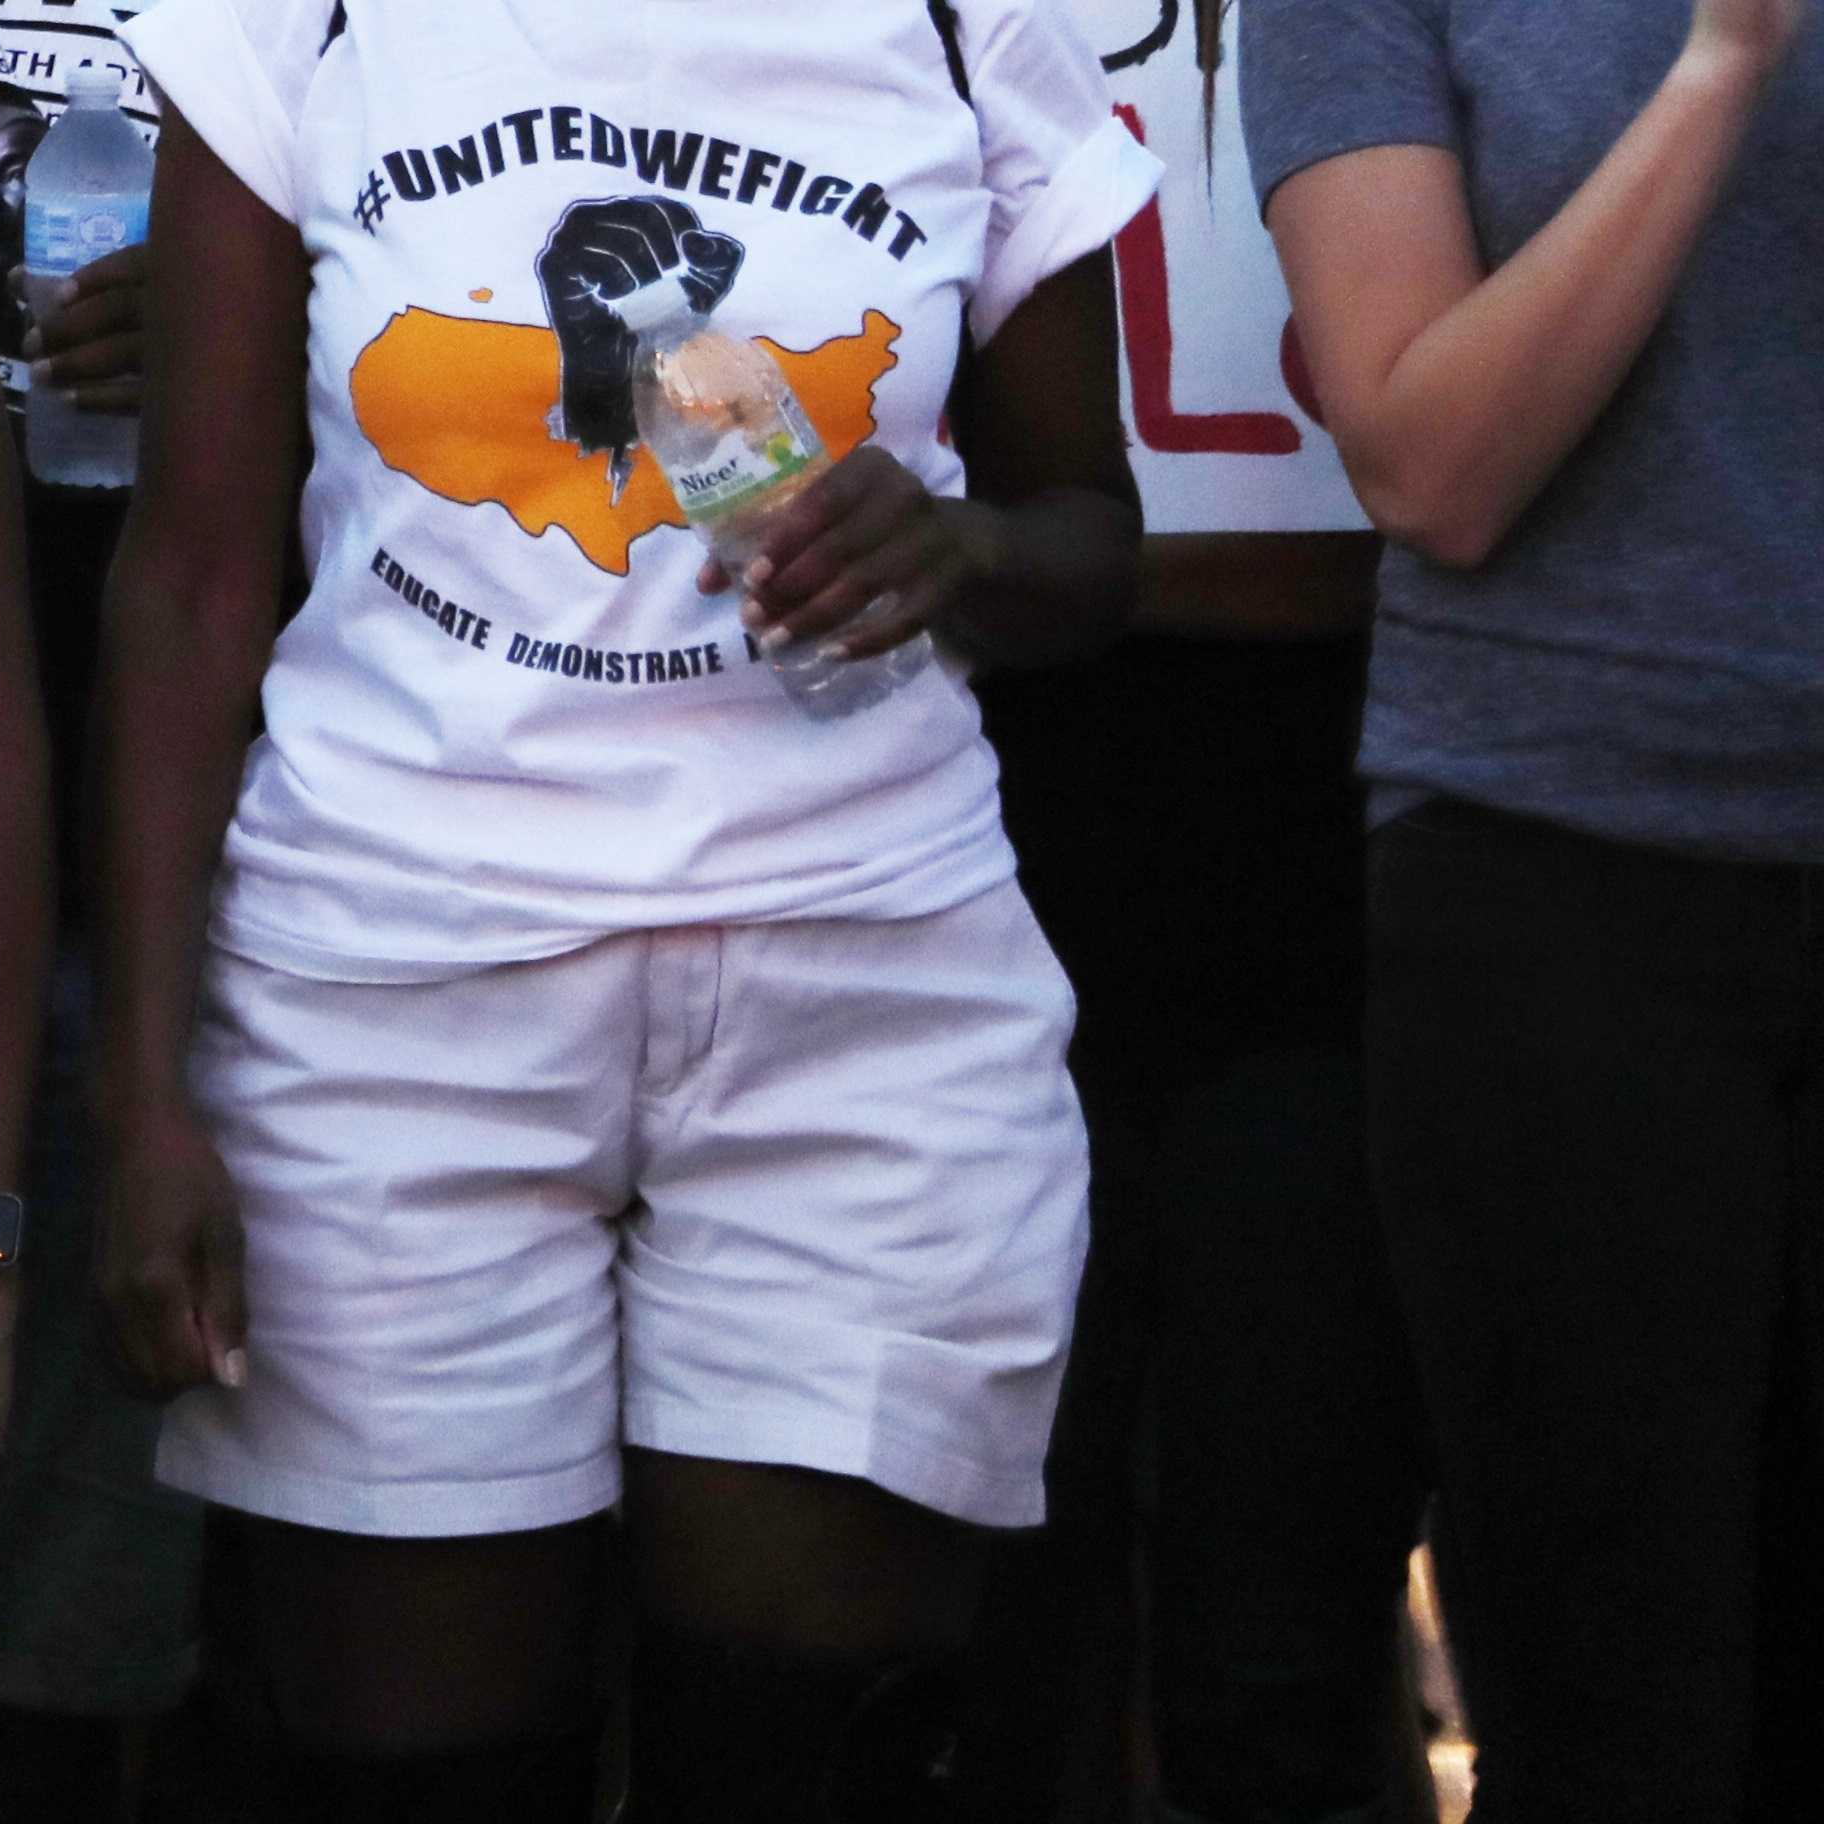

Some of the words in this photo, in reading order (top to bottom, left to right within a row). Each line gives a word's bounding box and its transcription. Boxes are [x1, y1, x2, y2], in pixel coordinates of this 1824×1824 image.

[353, 105, 929, 263] #UNITEDWEFIGHT
[369, 547, 491, 652] EDUCATE
[505, 631, 724, 684] DEMONSTRATE
